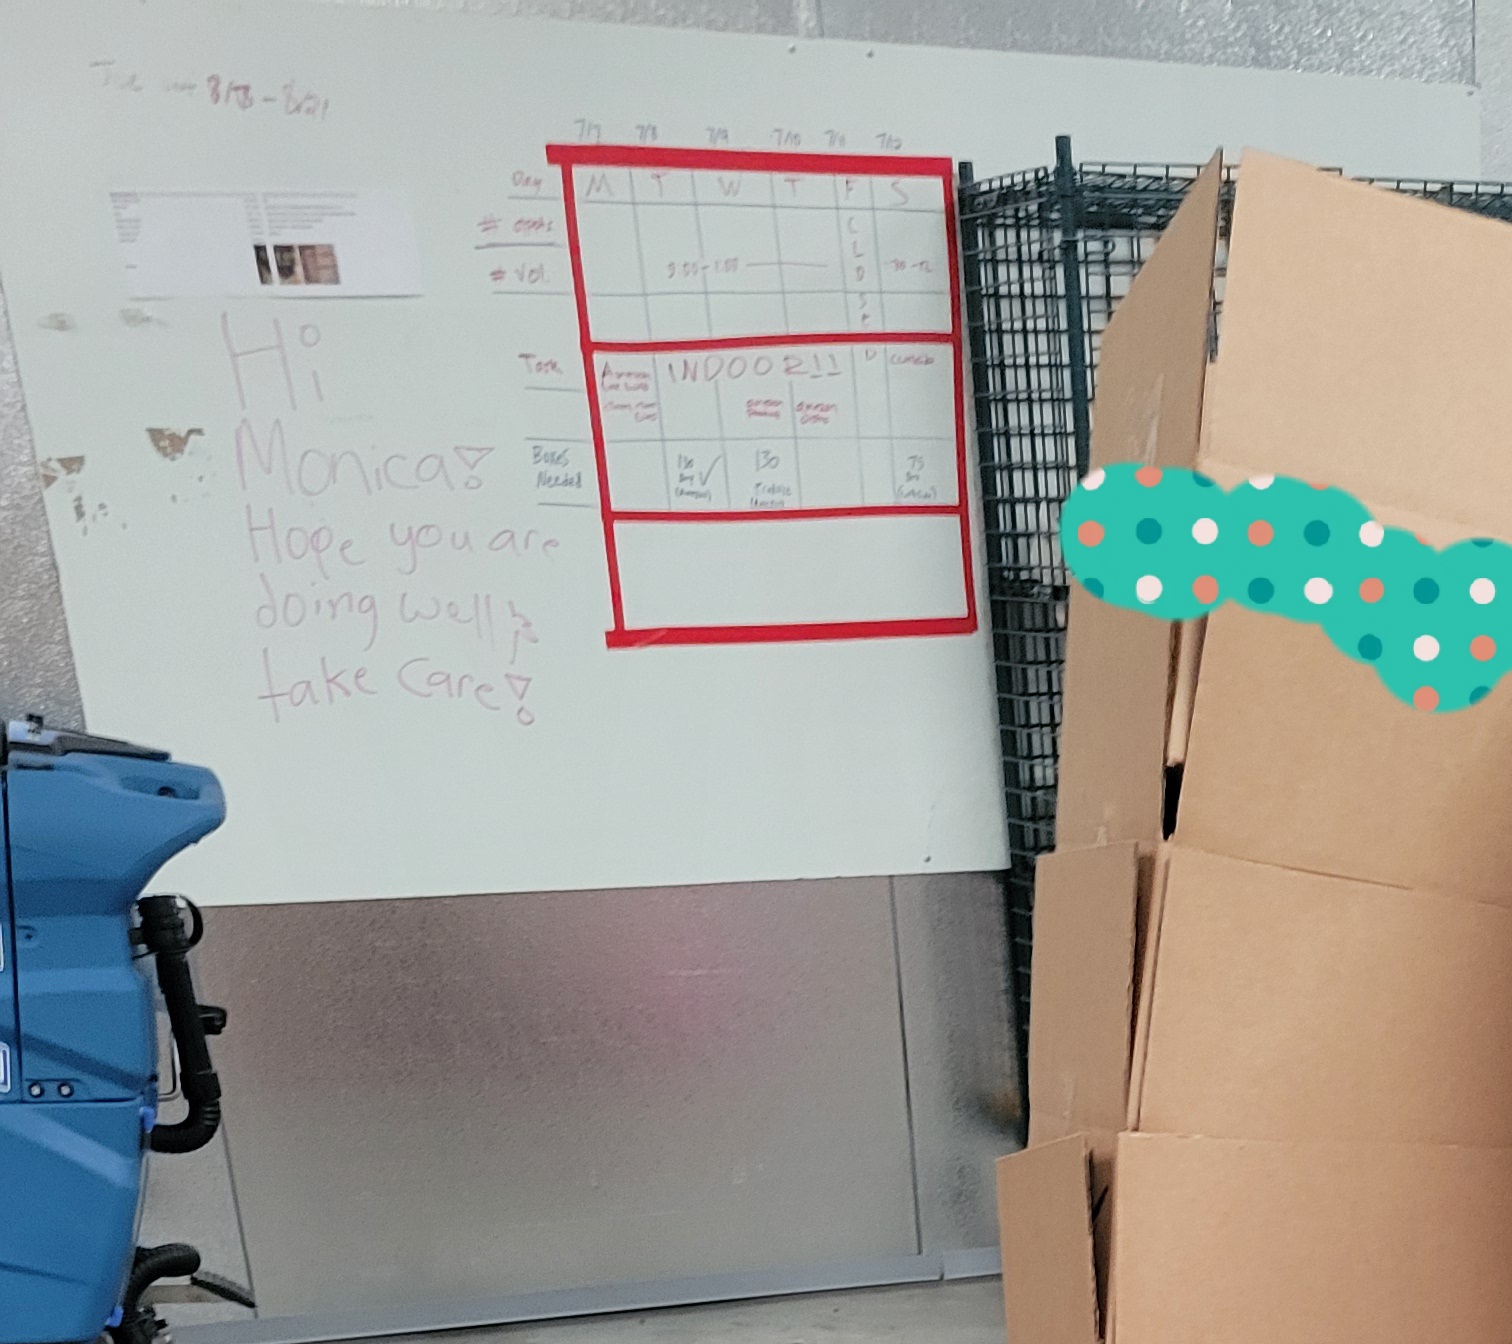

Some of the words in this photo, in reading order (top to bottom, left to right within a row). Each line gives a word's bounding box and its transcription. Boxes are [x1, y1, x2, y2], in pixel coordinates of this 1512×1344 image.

[584, 171, 615, 197] M
[716, 174, 742, 197] W
[783, 177, 803, 197] T
[890, 180, 910, 206] S
[246, 503, 366, 581] Hope
[388, 521, 474, 576] you
[488, 528, 561, 559] are
[256, 572, 379, 652] doing
